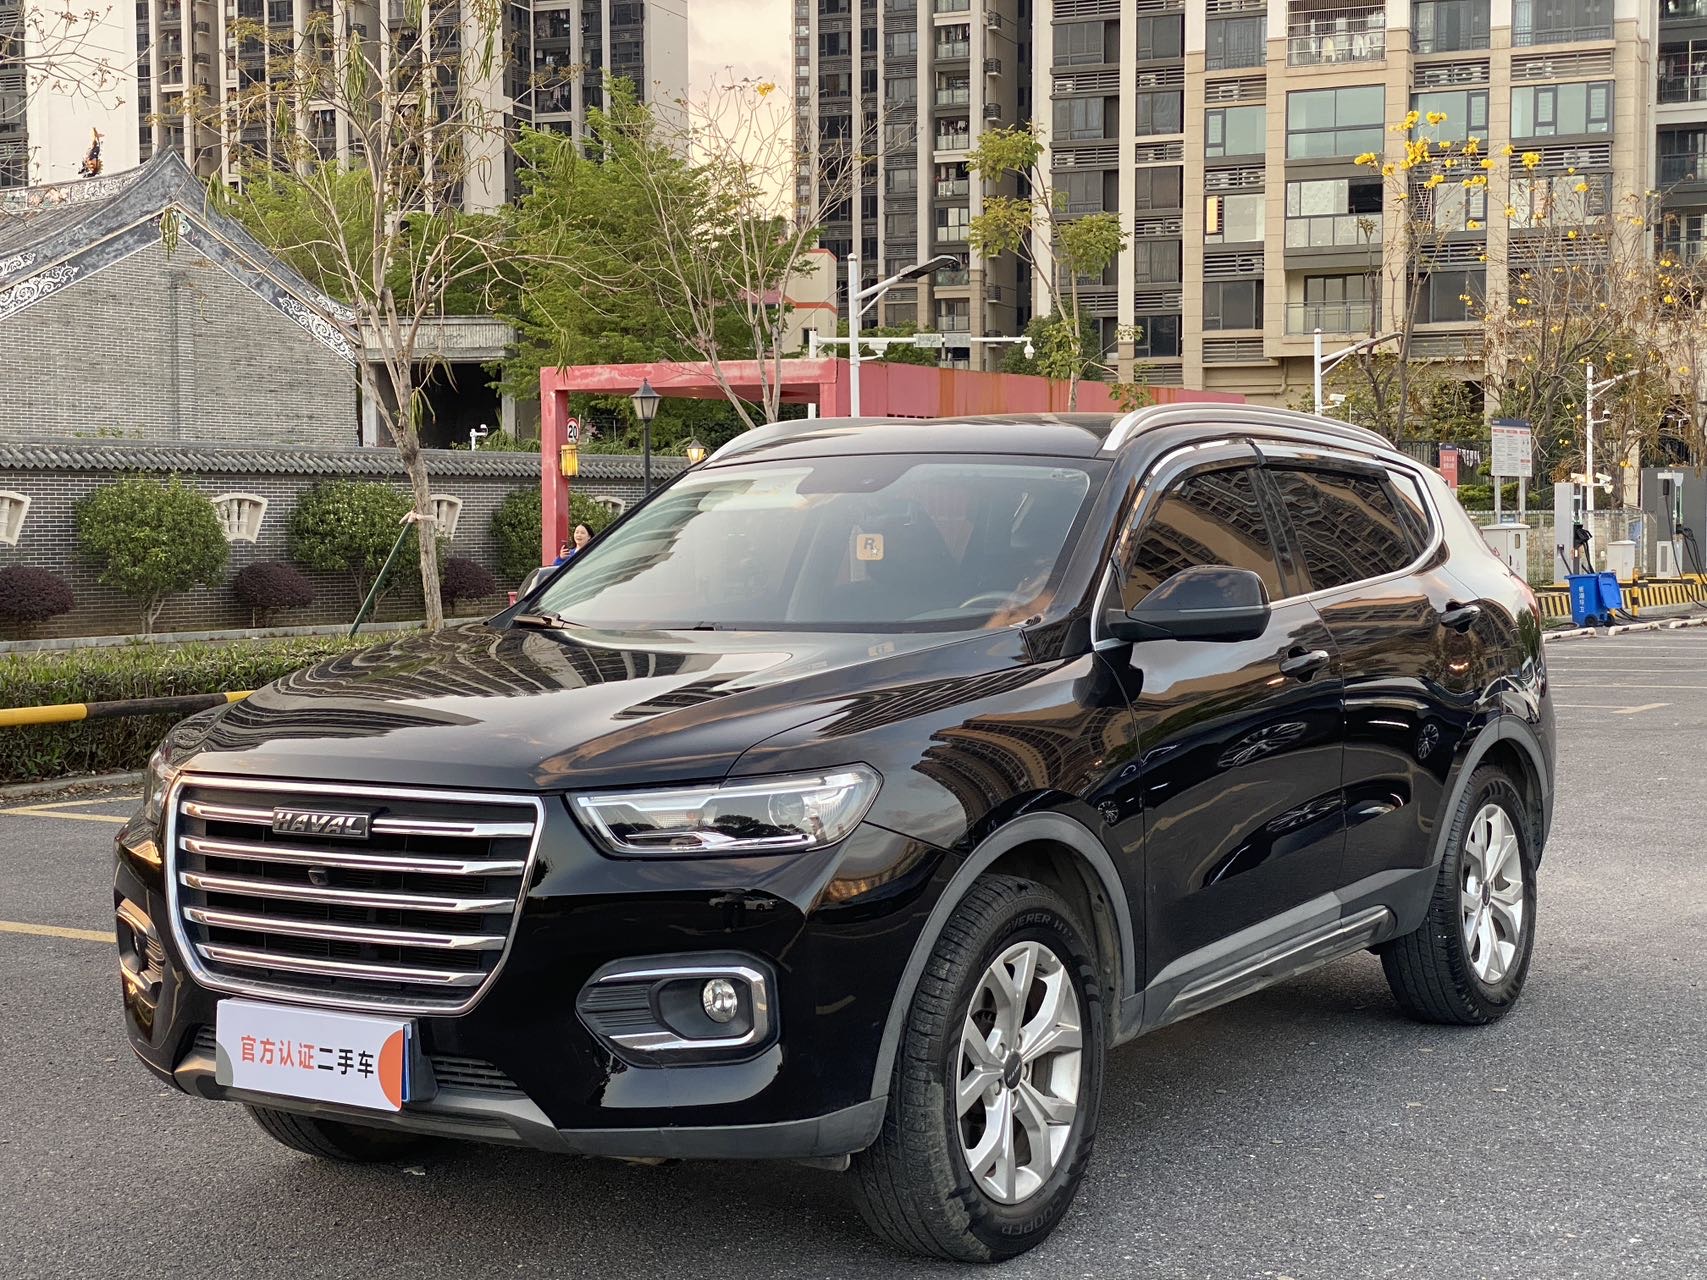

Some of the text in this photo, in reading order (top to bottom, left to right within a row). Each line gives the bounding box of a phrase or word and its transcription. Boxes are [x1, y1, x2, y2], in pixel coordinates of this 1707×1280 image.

[568, 424, 578, 439] 20
[275, 812, 362, 835] HAVAL
[241, 1034, 374, 1079] 官方认证二手车
[1001, 1196, 1064, 1236] COOPER
